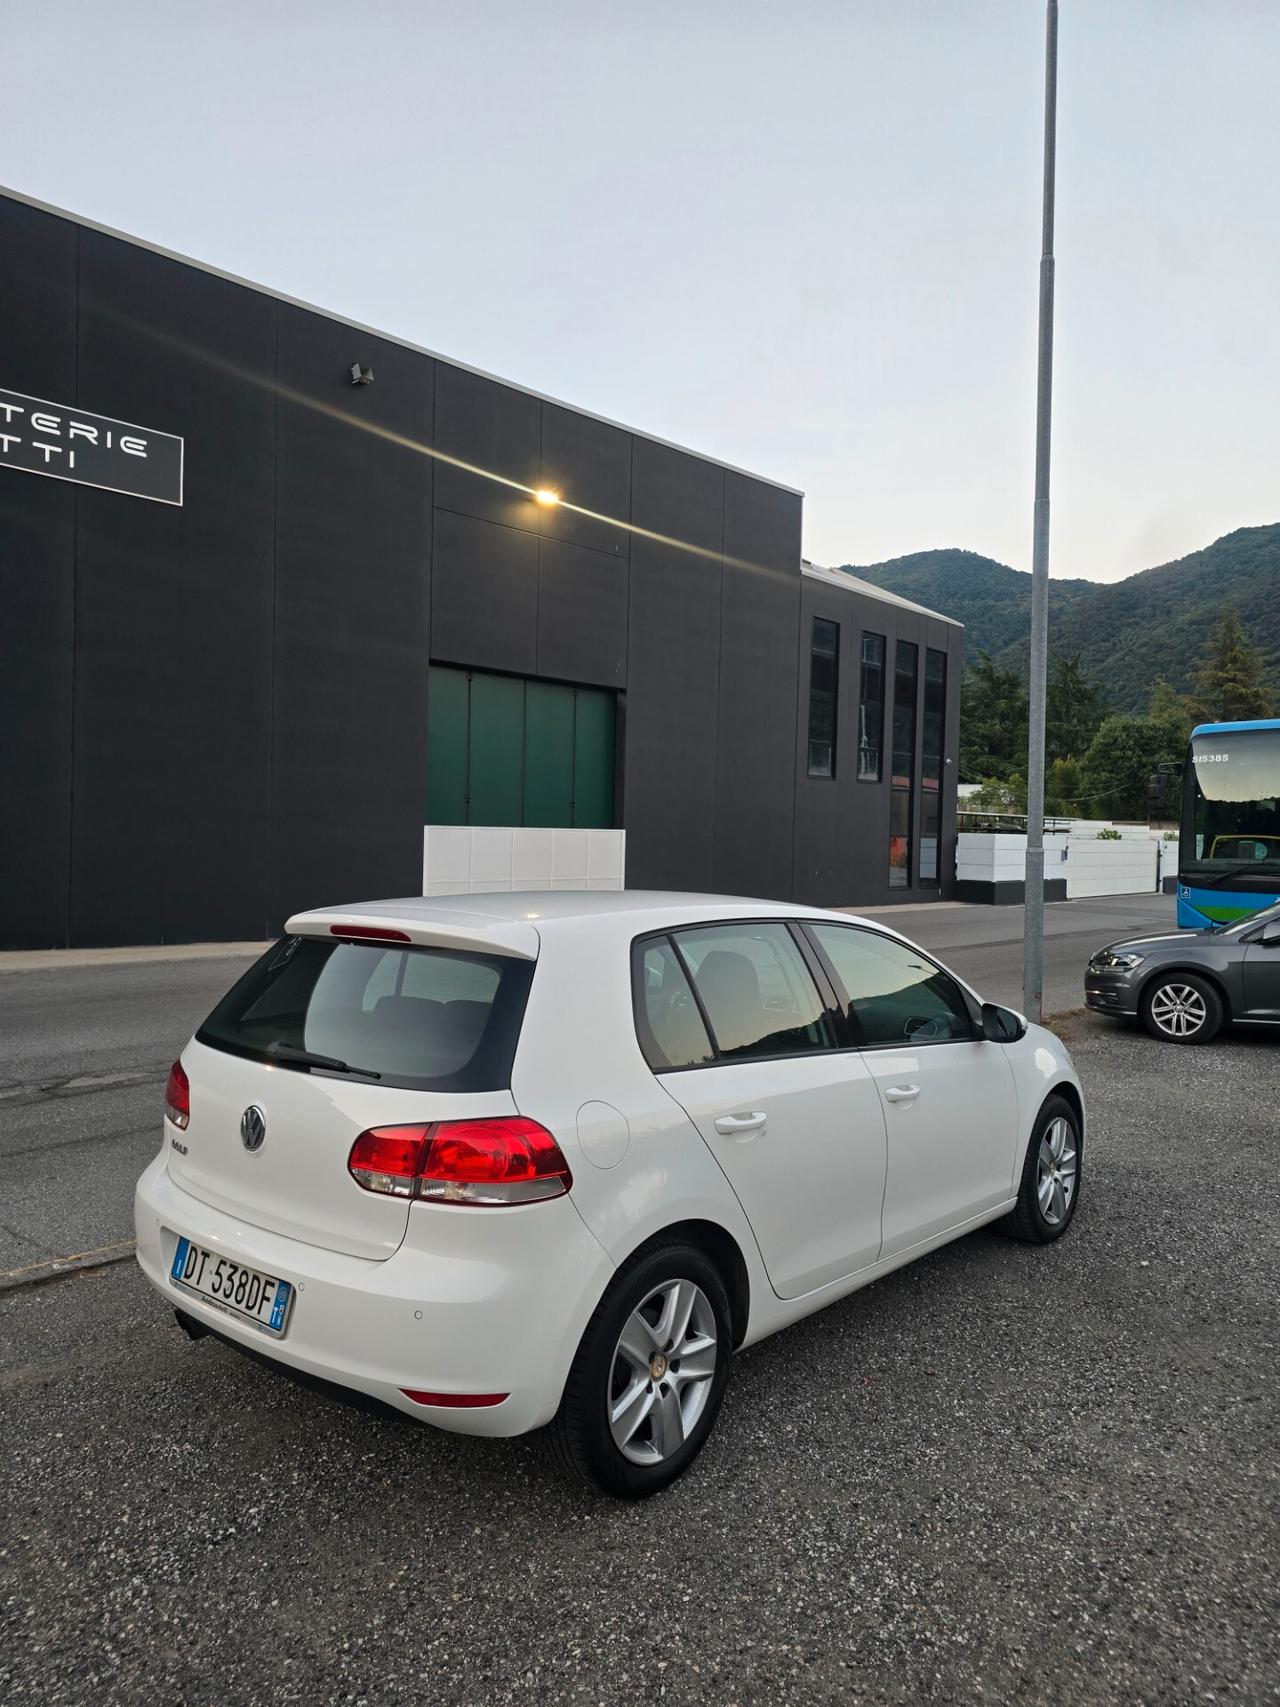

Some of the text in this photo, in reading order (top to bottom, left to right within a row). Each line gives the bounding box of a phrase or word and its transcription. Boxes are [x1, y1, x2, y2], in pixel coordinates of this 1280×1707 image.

[0, 402, 148, 458] TERIE
[0, 433, 75, 469] TTI
[183, 1245, 210, 1286] DT
[211, 1259, 276, 1315] 538DF
